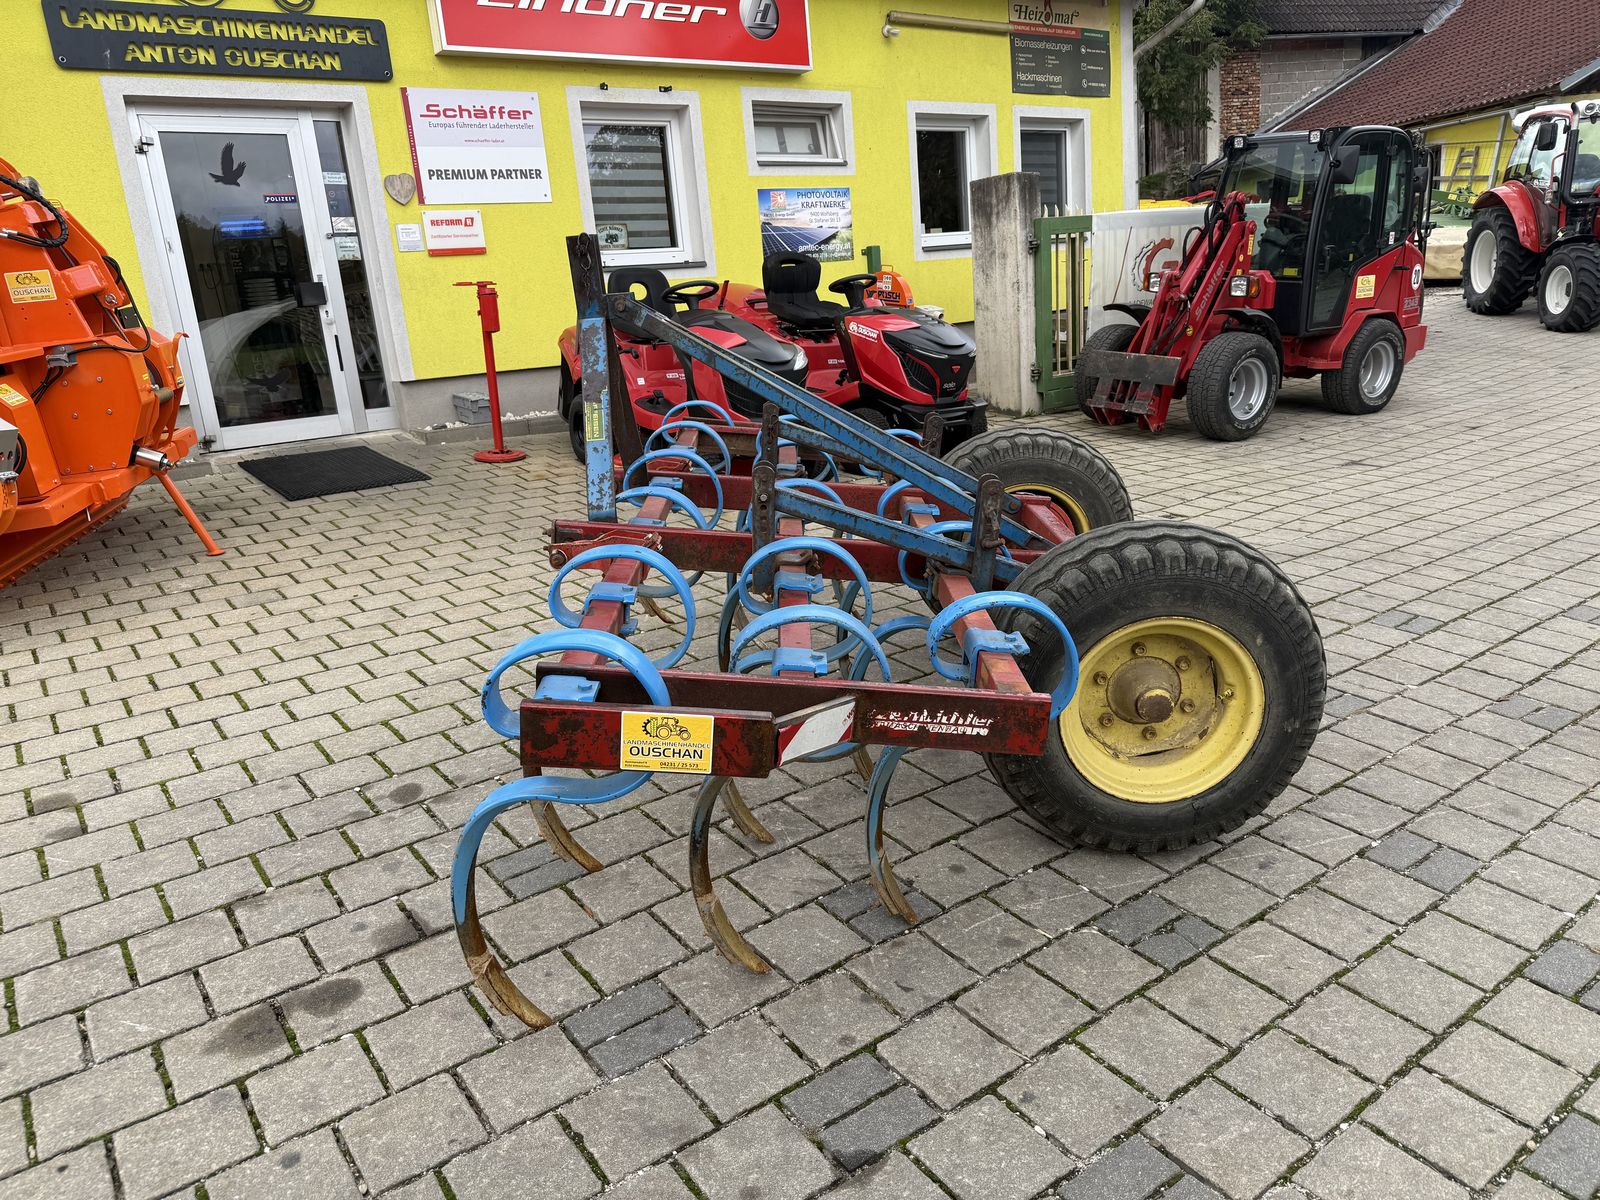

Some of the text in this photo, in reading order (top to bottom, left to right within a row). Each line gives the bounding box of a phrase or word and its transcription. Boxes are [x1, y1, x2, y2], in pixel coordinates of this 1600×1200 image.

[59, 5, 380, 46] LANDMASCHINENHANDEL
[1014, 38, 1073, 52] Biomasseheizungen
[124, 41, 343, 71] ANTON OUSCHAN
[1016, 71, 1063, 83] Hackmaschinen
[420, 104, 533, 120] Schäffer
[428, 121, 534, 130] Europas führender Laderhersteller
[428, 168, 543, 181] PREMIUM PARTNER
[796, 190, 848, 199] PHOTOVOLTAIK
[800, 200, 846, 209] KRAFTWERKE
[430, 218, 463, 227] REFORM
[1412, 268, 1421, 285] 20
[13, 287, 51, 297] OUSCHAN
[623, 739, 710, 749] LANDMASCHINENHANDEL
[629, 746, 703, 760] OUSCHAN
